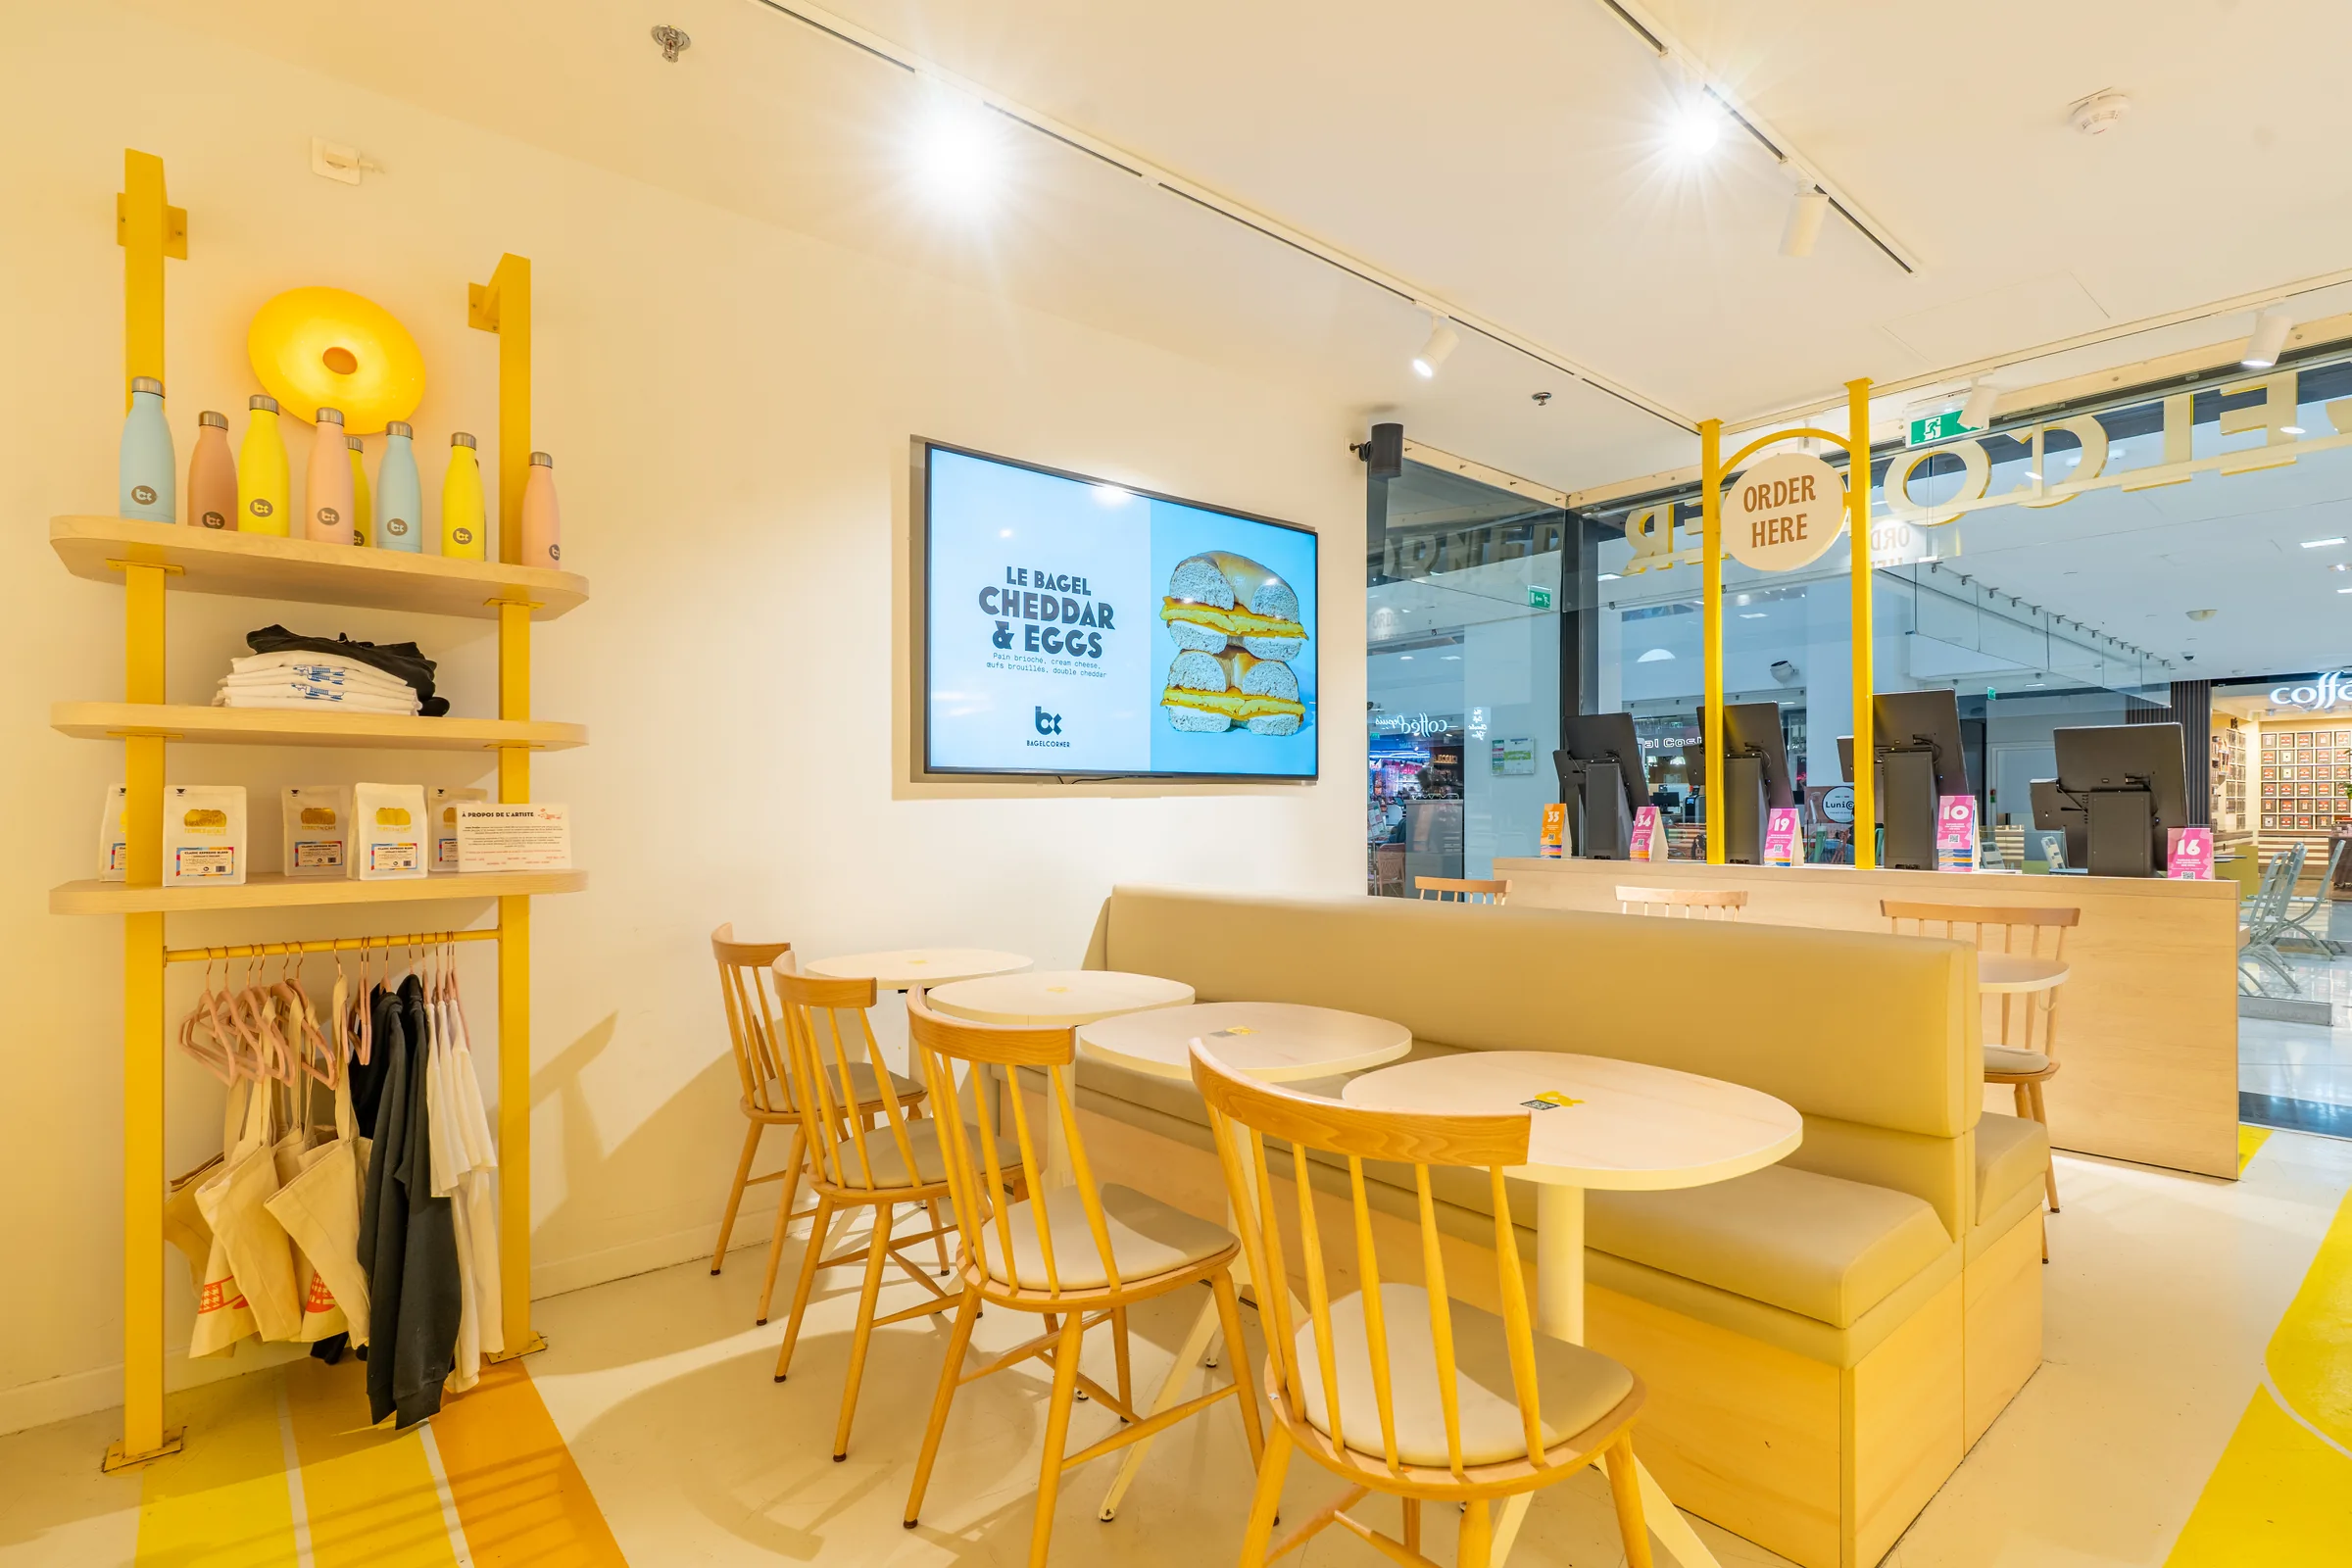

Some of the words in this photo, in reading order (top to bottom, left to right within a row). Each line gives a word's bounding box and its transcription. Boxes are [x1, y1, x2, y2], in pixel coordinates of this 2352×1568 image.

[1743, 474, 1816, 513] ORDER
[1751, 513, 1808, 549] HERE
[1006, 566, 1027, 586] LE
[1034, 570, 1092, 596] BAGEL
[978, 586, 1116, 630] CHEDDAR
[992, 620, 1014, 650] &
[1024, 623, 1102, 659] EGGS
[1053, 667, 1076, 676] double
[1080, 669, 1107, 679] cheddar
[1547, 811, 1559, 822] 35
[1639, 815, 1651, 827] 34
[1943, 806, 1969, 820] 10
[1774, 817, 1789, 832] 19
[2178, 839, 2201, 856] 16
